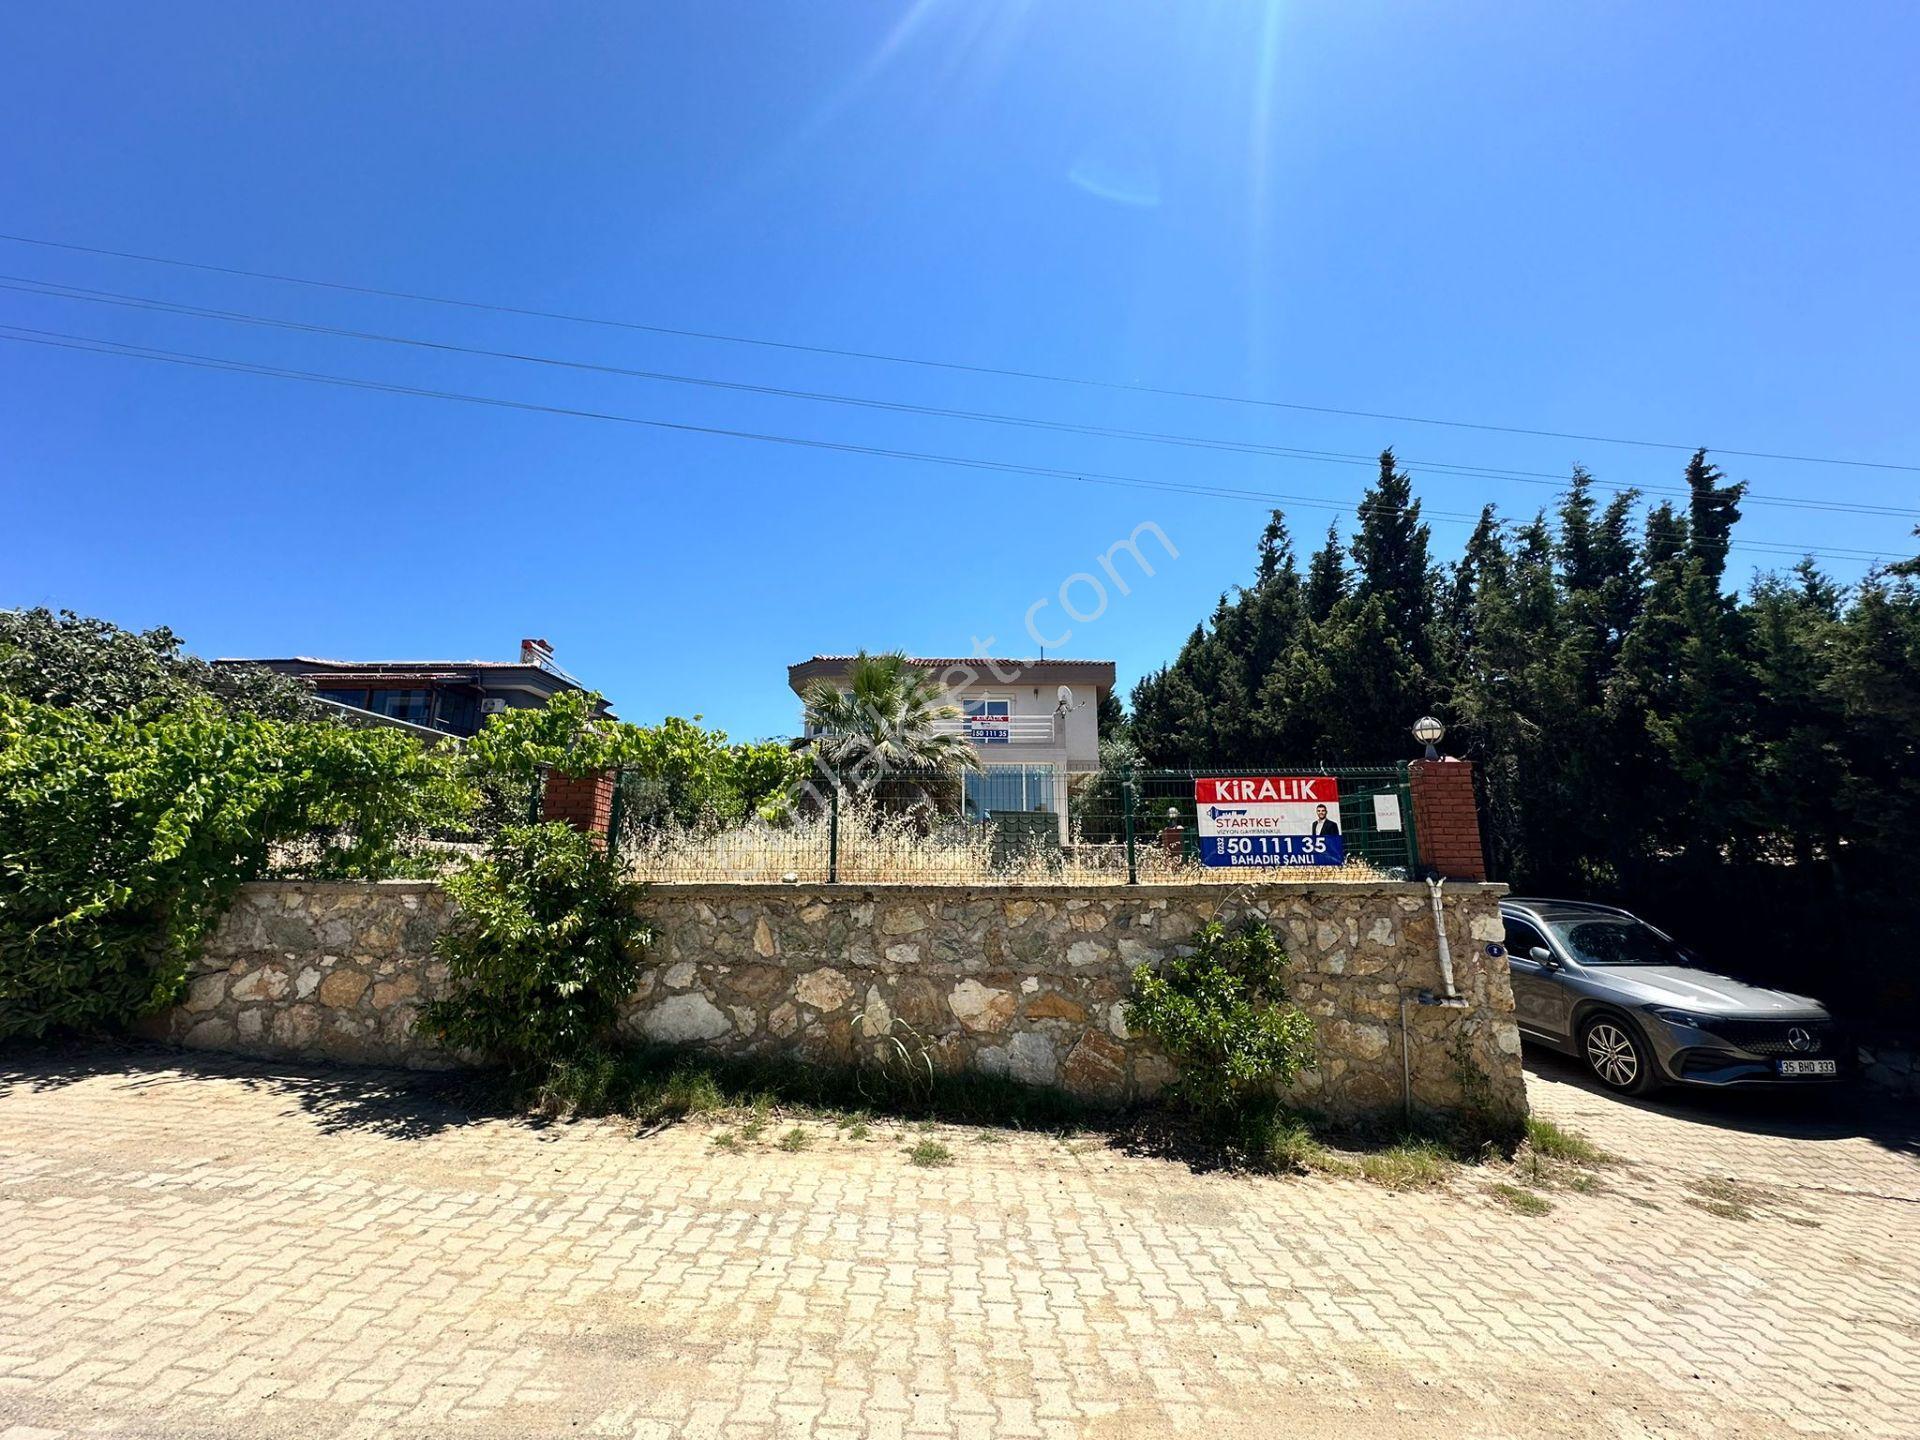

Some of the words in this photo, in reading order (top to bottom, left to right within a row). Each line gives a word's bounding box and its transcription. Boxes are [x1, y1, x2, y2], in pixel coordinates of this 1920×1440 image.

[1216, 818, 1279, 828] STARTKEY
[1227, 837, 1252, 854] 50
[1259, 837, 1292, 853] 111
[1302, 837, 1327, 853] 35
[1231, 855, 1280, 865] BAHADIR
[1283, 854, 1315, 866] ŞANLI
[1783, 1061, 1795, 1072] 35
[1799, 1061, 1815, 1072] BHD
[1818, 1061, 1835, 1072] 333
